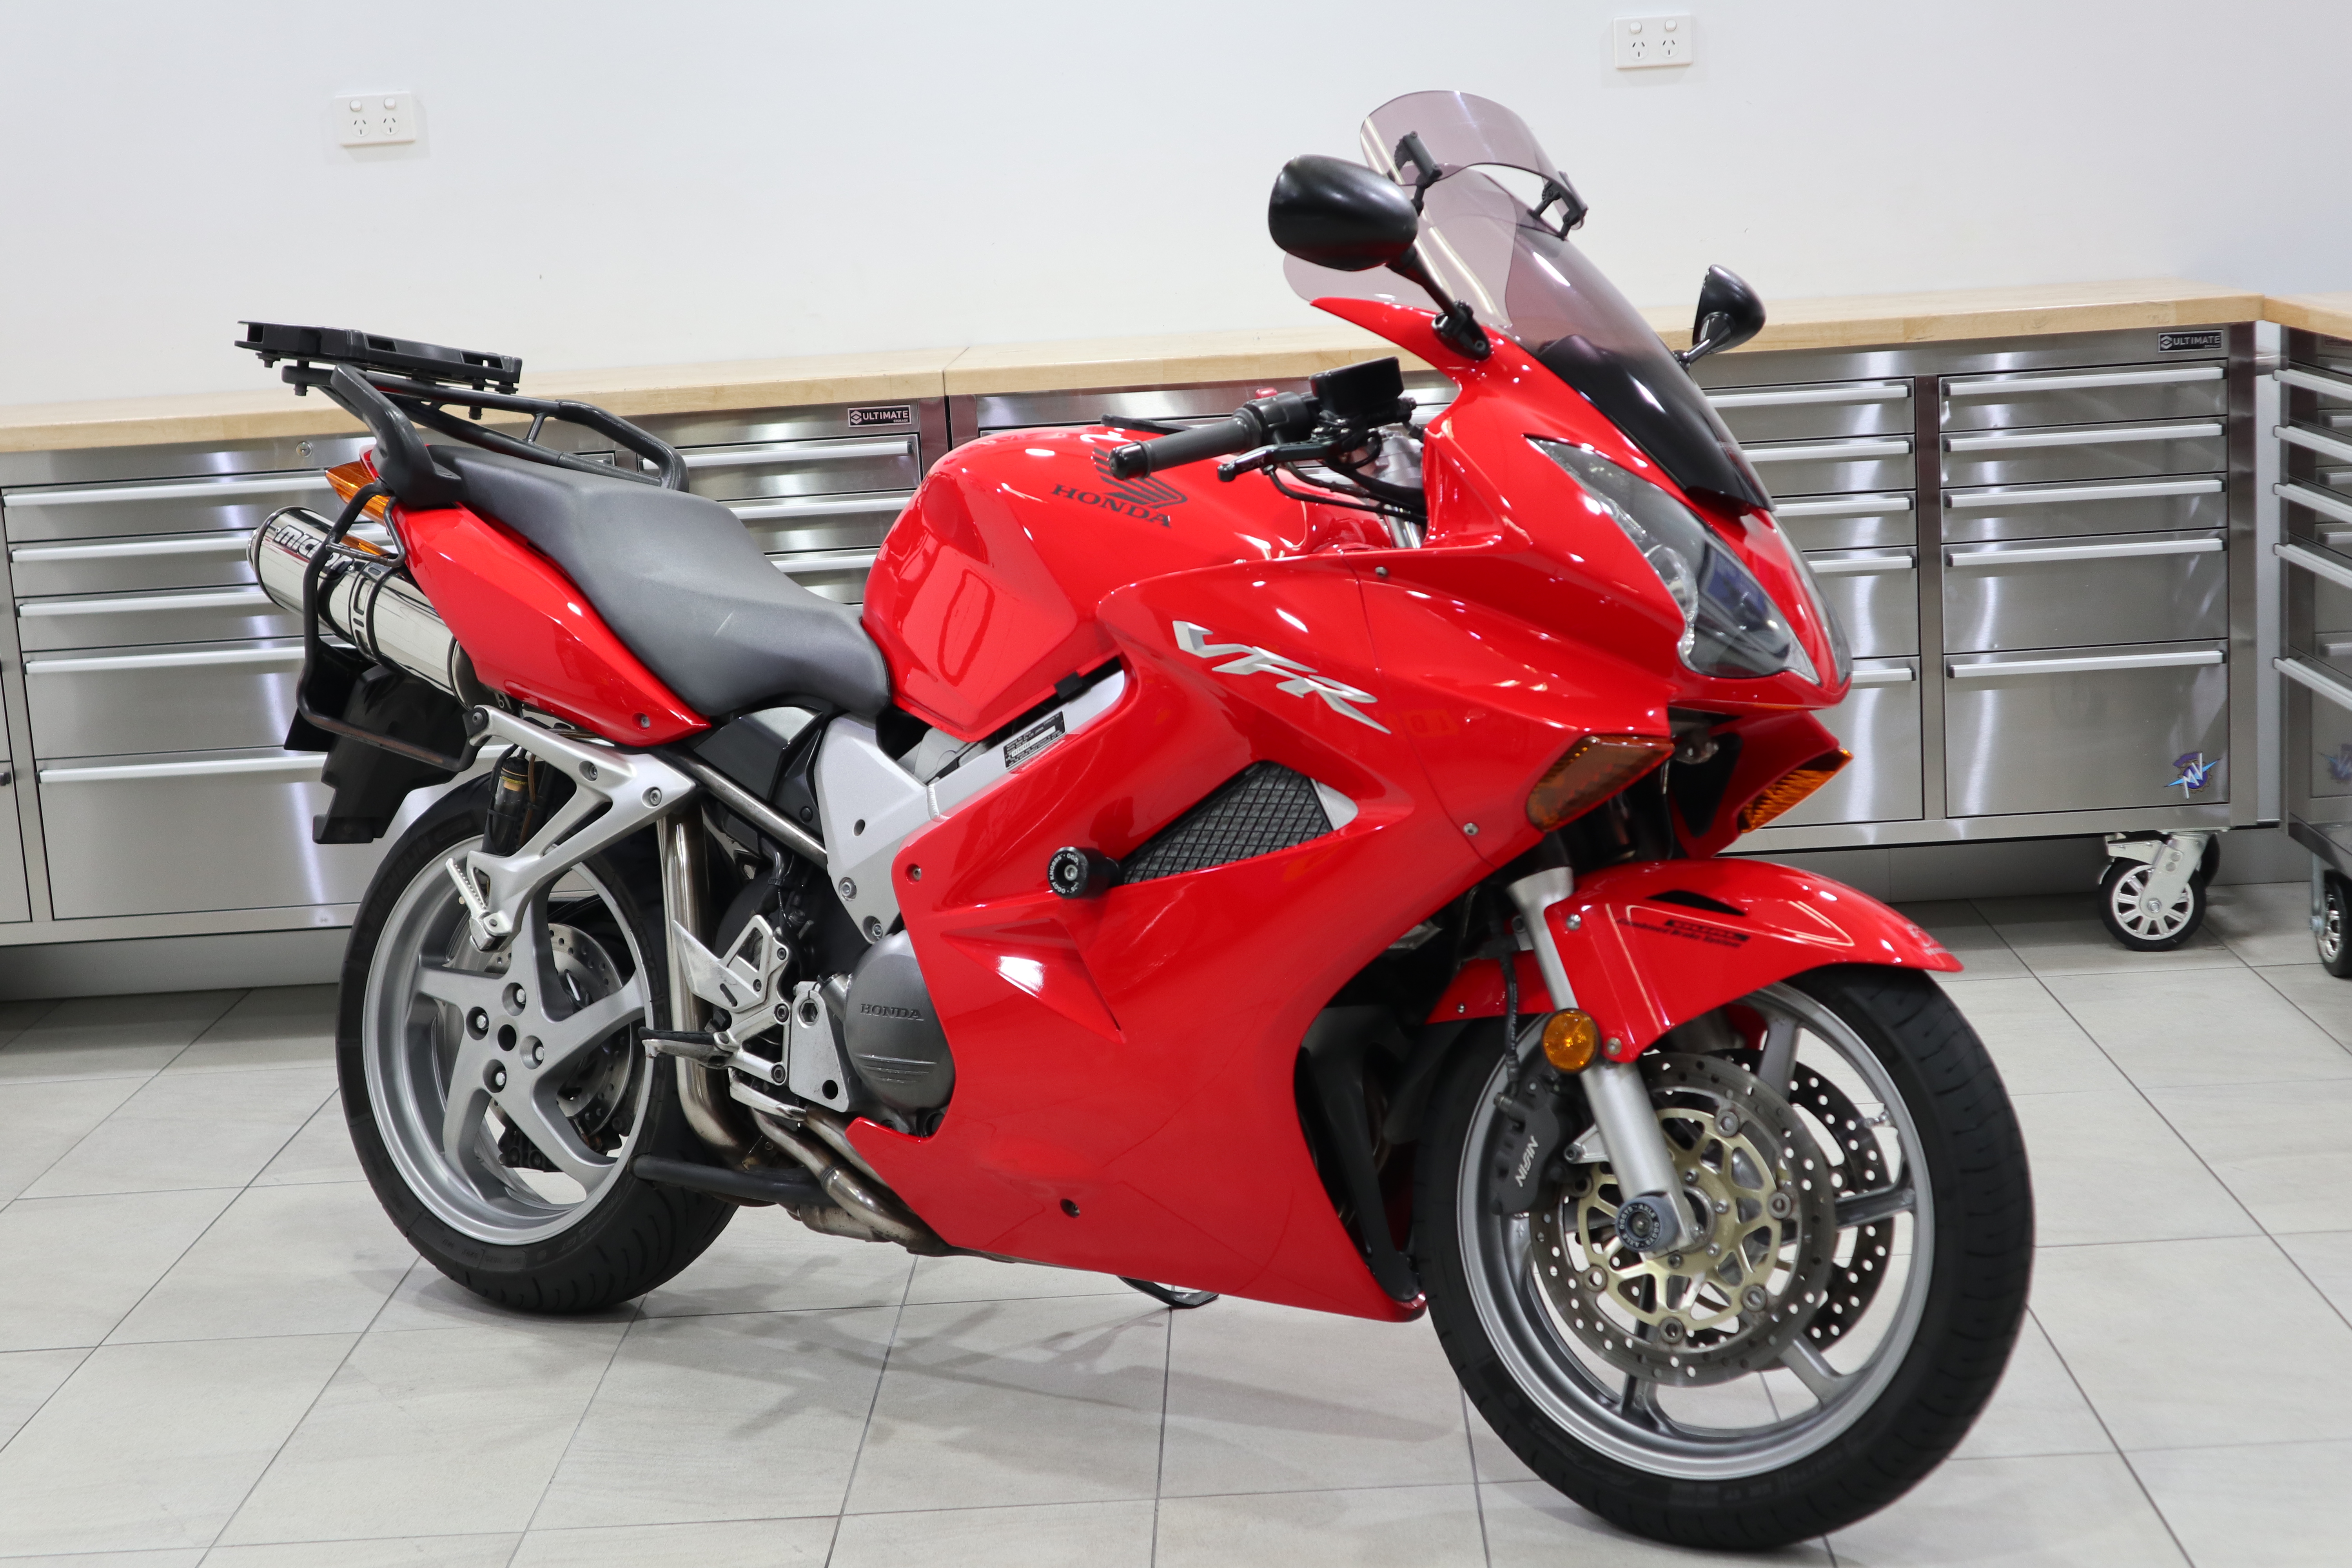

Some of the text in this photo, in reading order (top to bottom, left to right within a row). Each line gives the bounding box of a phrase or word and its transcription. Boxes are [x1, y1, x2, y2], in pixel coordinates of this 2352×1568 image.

[2173, 335, 2221, 345] ULTIMATE
[862, 410, 909, 421] ULTIMATE
[1051, 484, 1172, 528] HONDA
[1172, 620, 1392, 735] VFR
[1067, 853, 1078, 866] OGG
[860, 1003, 924, 1022] HONDA
[1515, 1134, 1539, 1188] NISSIN
